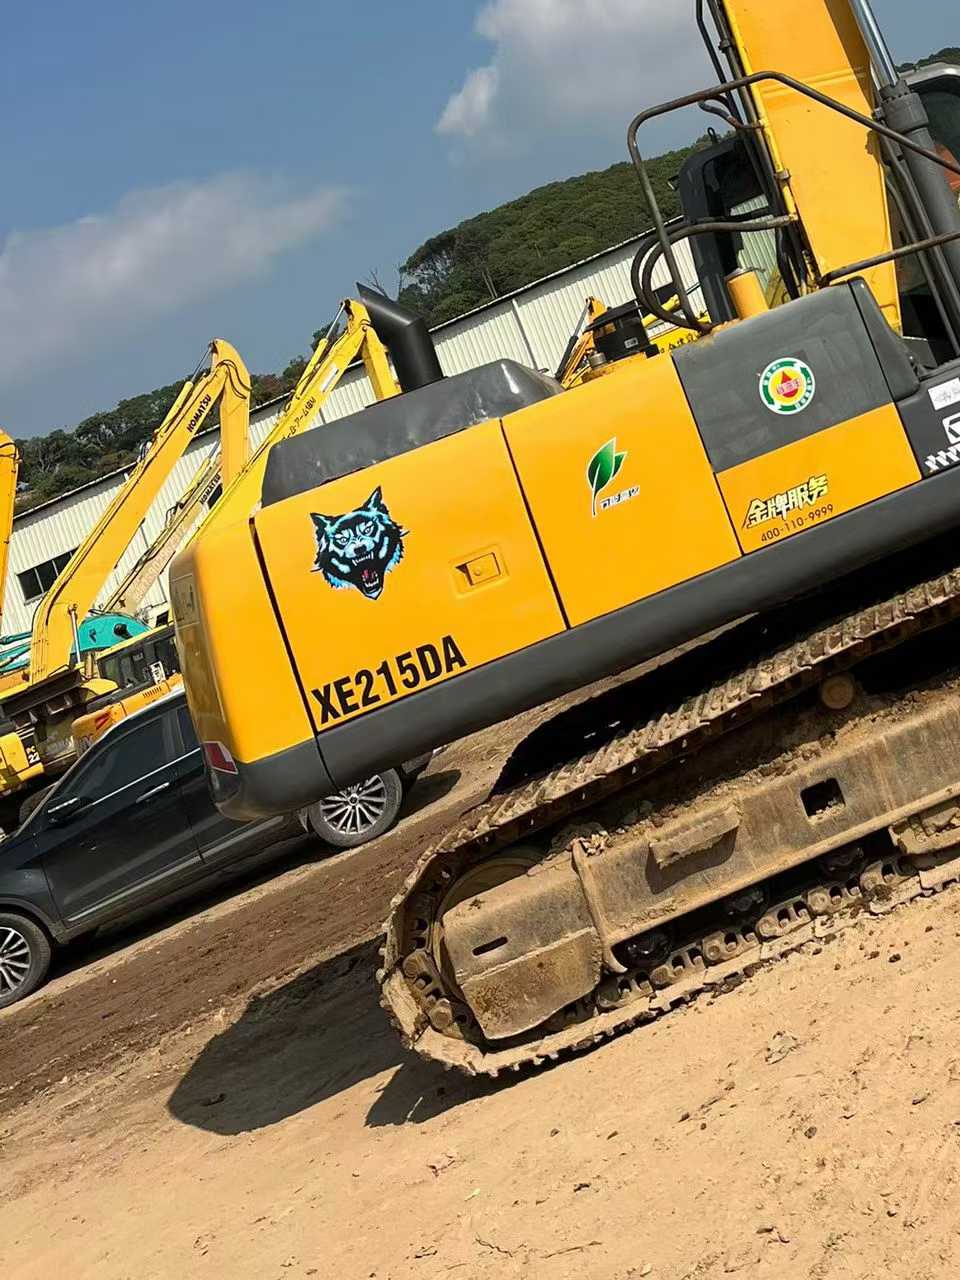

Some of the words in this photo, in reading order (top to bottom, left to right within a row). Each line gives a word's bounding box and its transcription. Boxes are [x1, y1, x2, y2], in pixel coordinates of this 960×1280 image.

[186, 393, 212, 433] KOMATSU
[745, 473, 829, 529] 金牌服务
[761, 504, 834, 542] 400-110-9999
[311, 634, 468, 725] XE215DA
